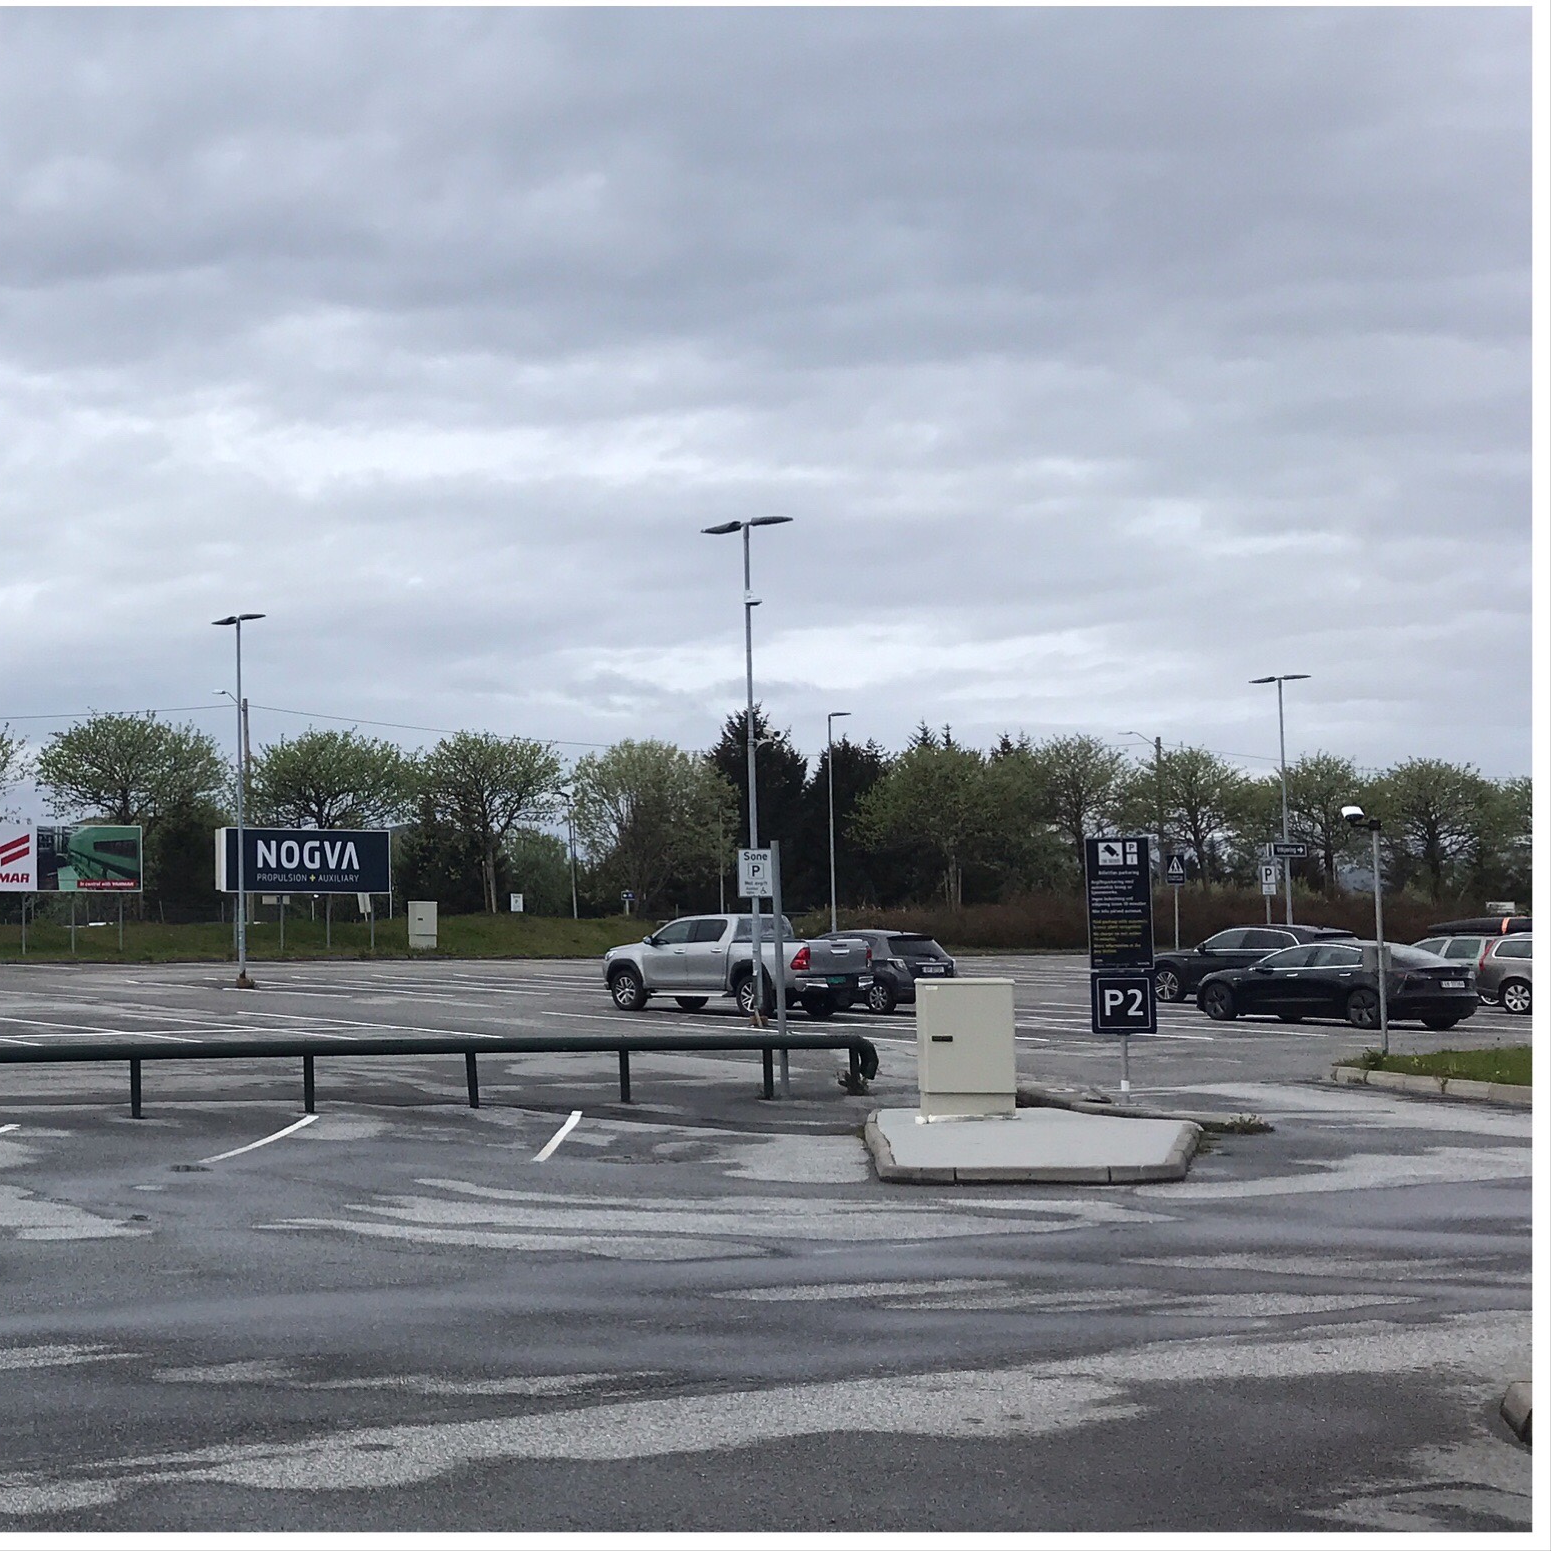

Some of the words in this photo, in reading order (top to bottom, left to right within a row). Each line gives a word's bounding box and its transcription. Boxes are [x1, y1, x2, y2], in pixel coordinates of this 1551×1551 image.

[256, 839, 360, 870] NOGVA
[743, 851, 768, 861] Sone
[752, 865, 760, 877] P
[1265, 868, 1272, 881] P
[256, 873, 308, 882] PROPULSION
[317, 874, 360, 883] AUXILIARY
[1104, 989, 1144, 1016] P2
